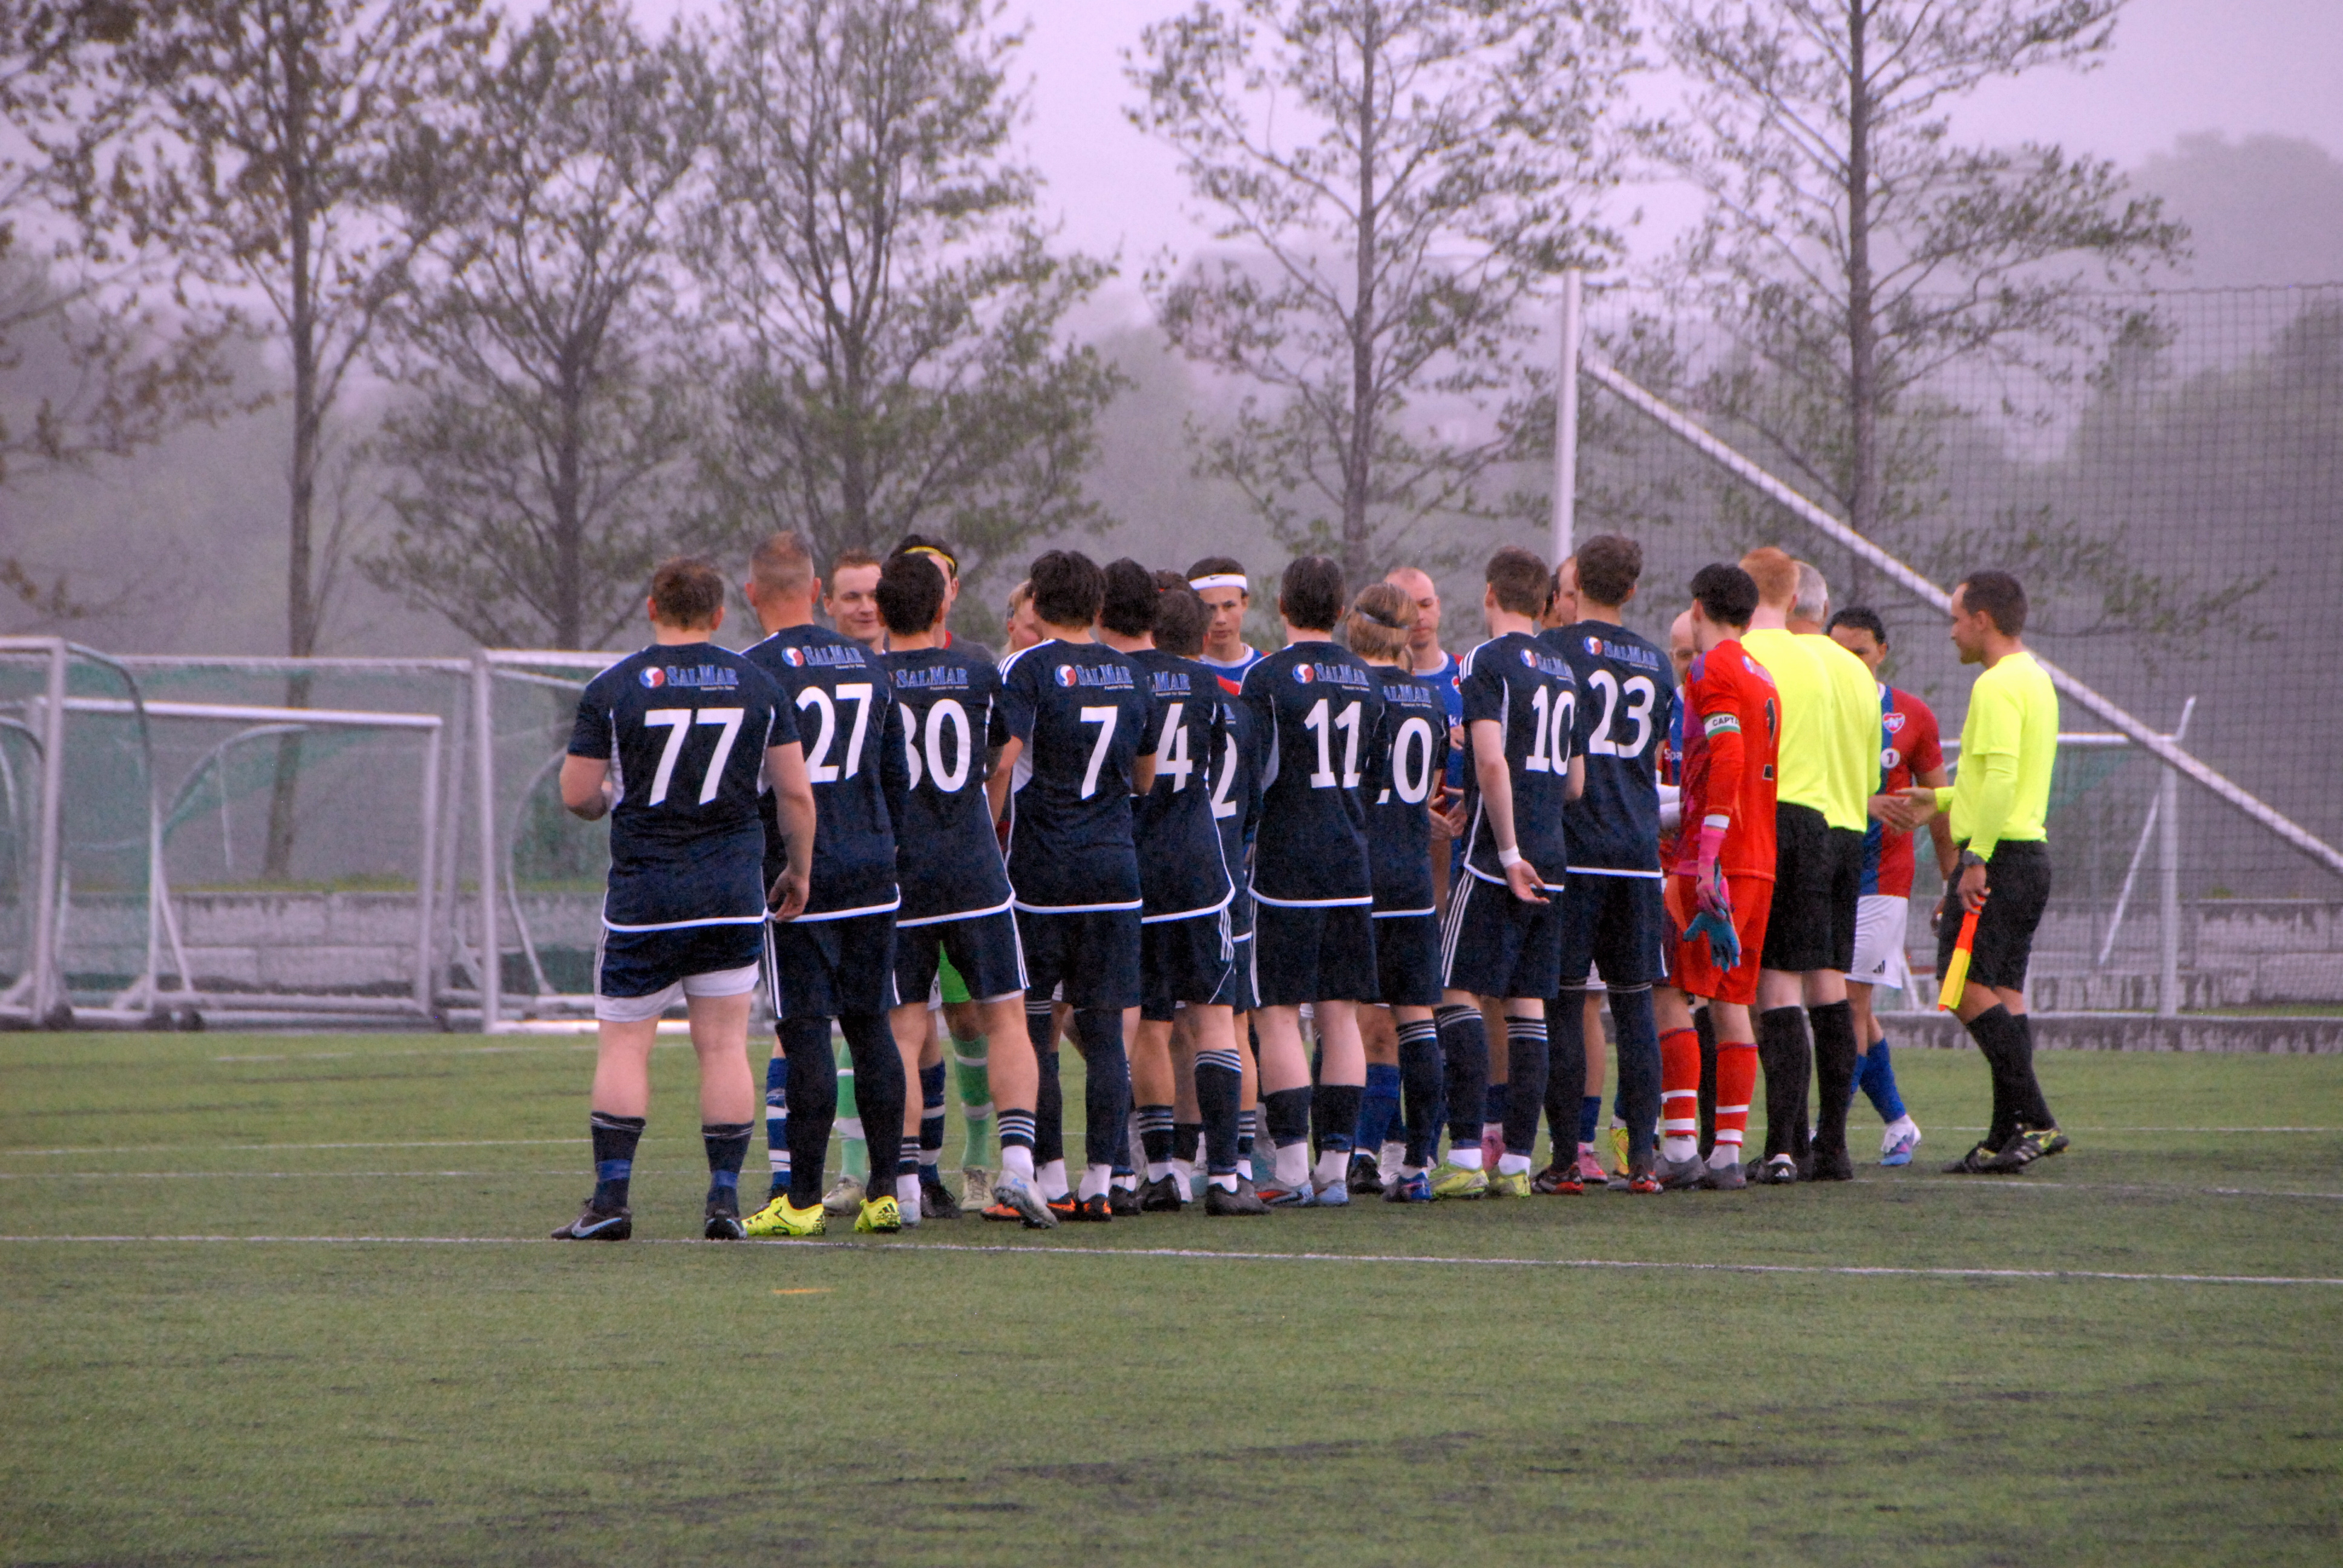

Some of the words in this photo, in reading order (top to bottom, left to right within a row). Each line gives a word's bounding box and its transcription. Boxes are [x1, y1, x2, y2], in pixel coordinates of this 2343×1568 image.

[644, 708, 744, 806] 77
[796, 683, 873, 783] 27
[1080, 706, 1118, 800] 7
[1152, 703, 1193, 794] 4
[1304, 699, 1362, 788] 11
[1525, 684, 1575, 776] 10
[1588, 669, 1655, 759] 23
[1376, 717, 1432, 804] 0
